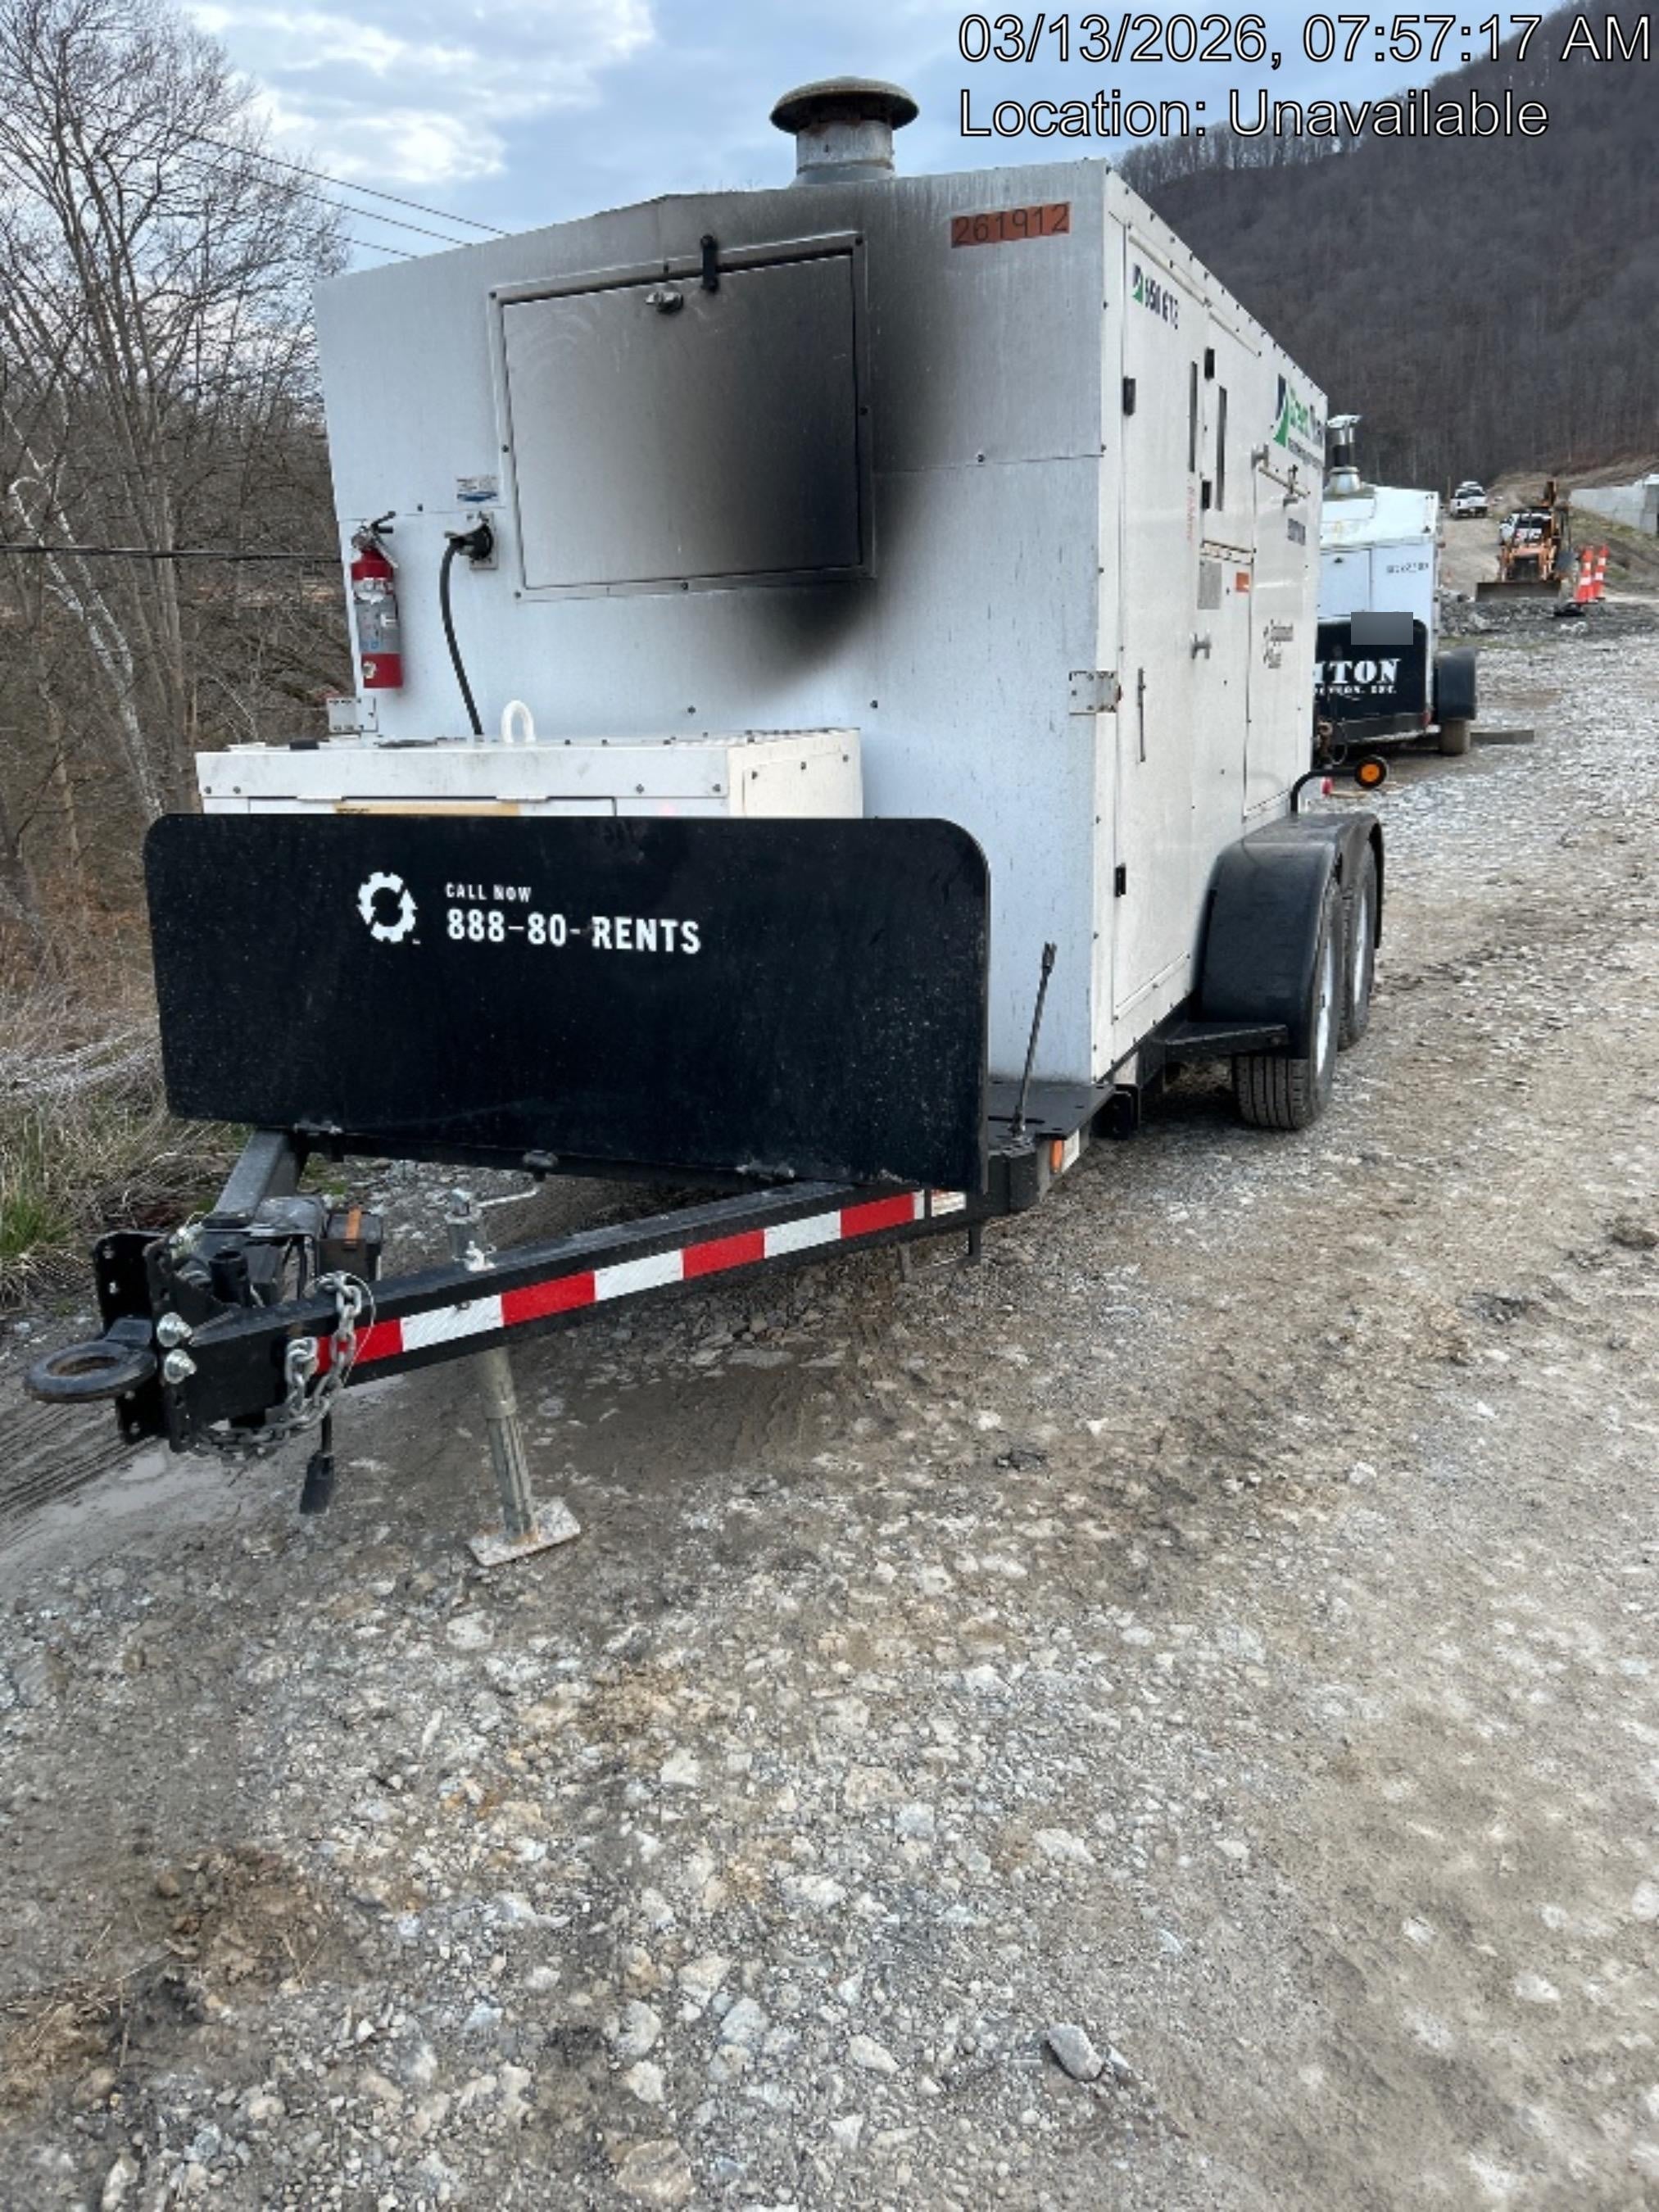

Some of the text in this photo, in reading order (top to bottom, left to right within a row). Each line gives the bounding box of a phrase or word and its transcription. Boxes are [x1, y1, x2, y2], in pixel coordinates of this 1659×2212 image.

[954, 203, 1070, 244] 261912
[445, 882, 533, 903] CALL NOW
[446, 908, 702, 955] 888-80-RENTS
